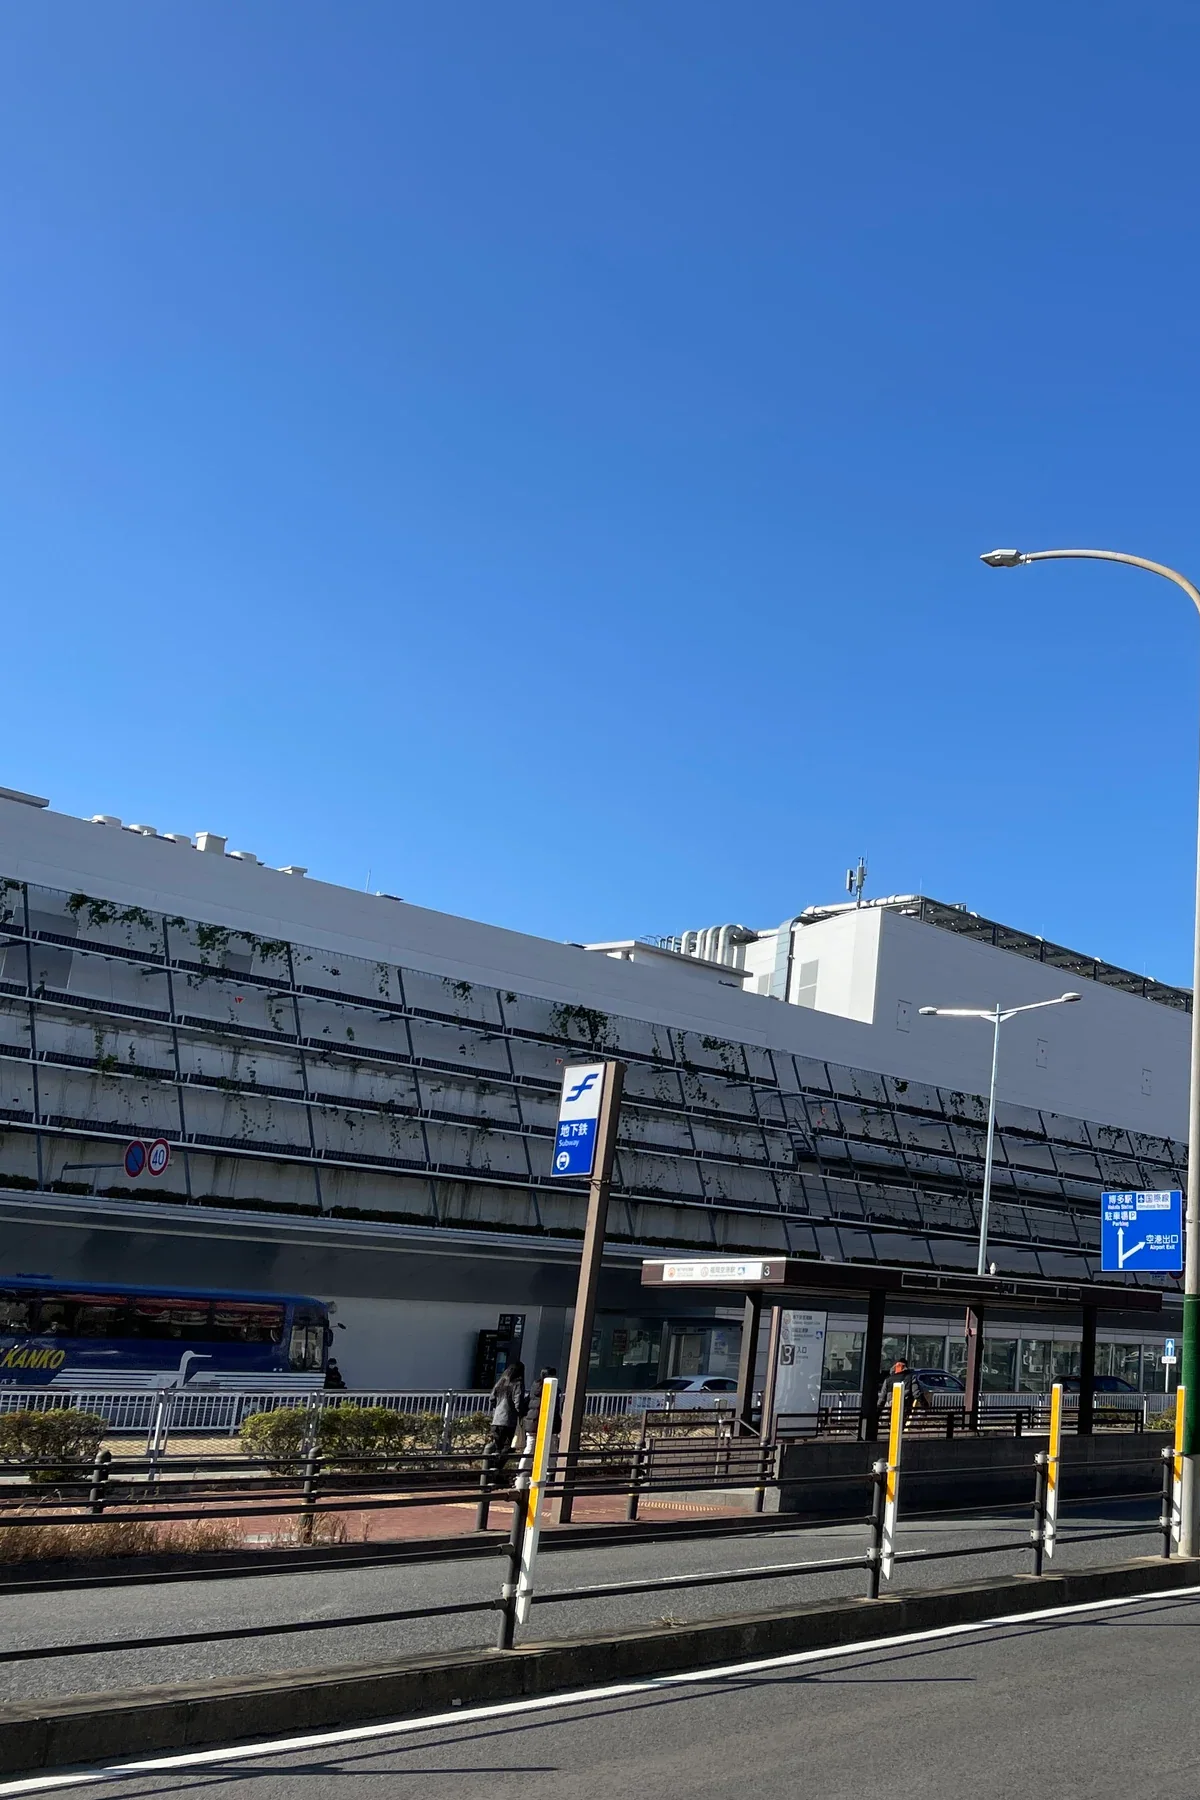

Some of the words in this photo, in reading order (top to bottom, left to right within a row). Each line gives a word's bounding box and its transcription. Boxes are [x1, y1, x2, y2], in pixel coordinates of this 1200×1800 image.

[560, 1122, 588, 1137] 地下鉄
[559, 1139, 579, 1147] Subway
[152, 1149, 165, 1165] 40
[1108, 1194, 1133, 1204] 博多駅
[1145, 1193, 1169, 1203] 国際線
[1105, 1211, 1129, 1221] 駐車場
[1146, 1235, 1178, 1244] 空港出口
[763, 1266, 770, 1276] 3
[0, 1348, 66, 1369] KANKO
[783, 1346, 792, 1364] 3
